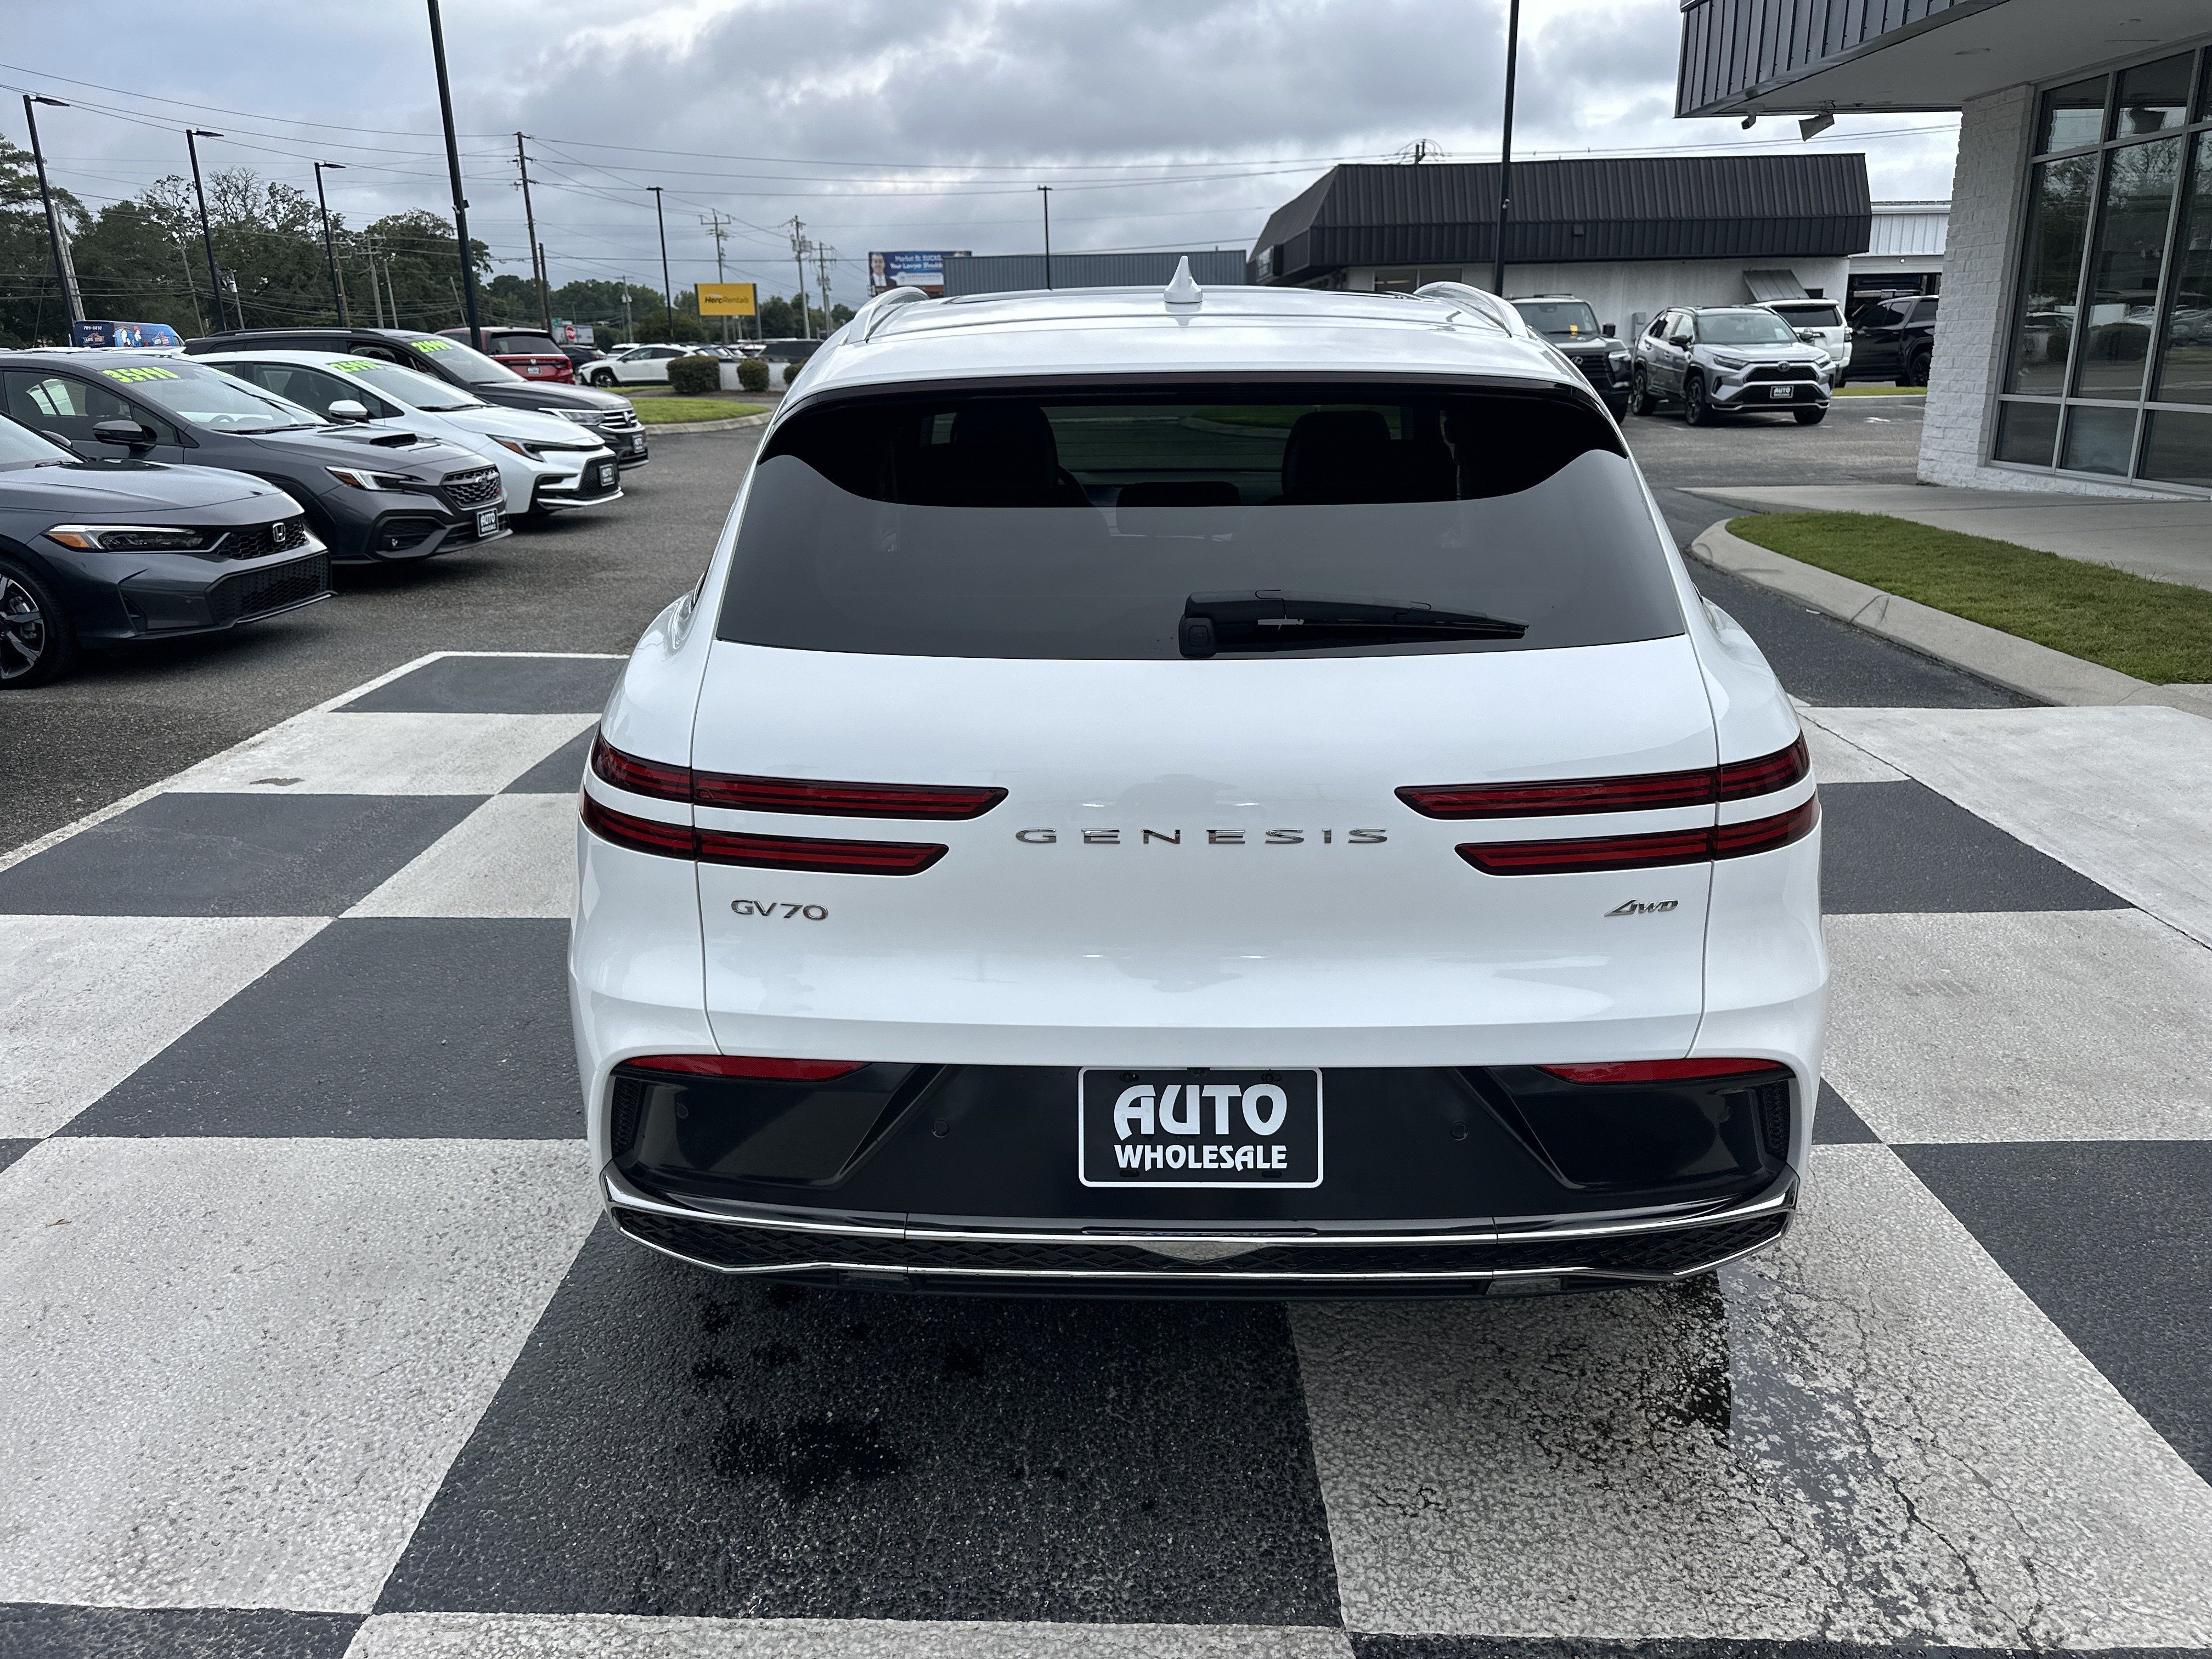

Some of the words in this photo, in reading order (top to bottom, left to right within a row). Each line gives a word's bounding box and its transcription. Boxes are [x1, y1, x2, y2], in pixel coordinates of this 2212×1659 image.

[481, 512, 495, 527] AUTO
[1015, 827, 1388, 845] GENESIS
[731, 899, 829, 921] GV70
[1114, 1084, 1287, 1141] AUTO
[1114, 1144, 1288, 1172] WHOLESALE
